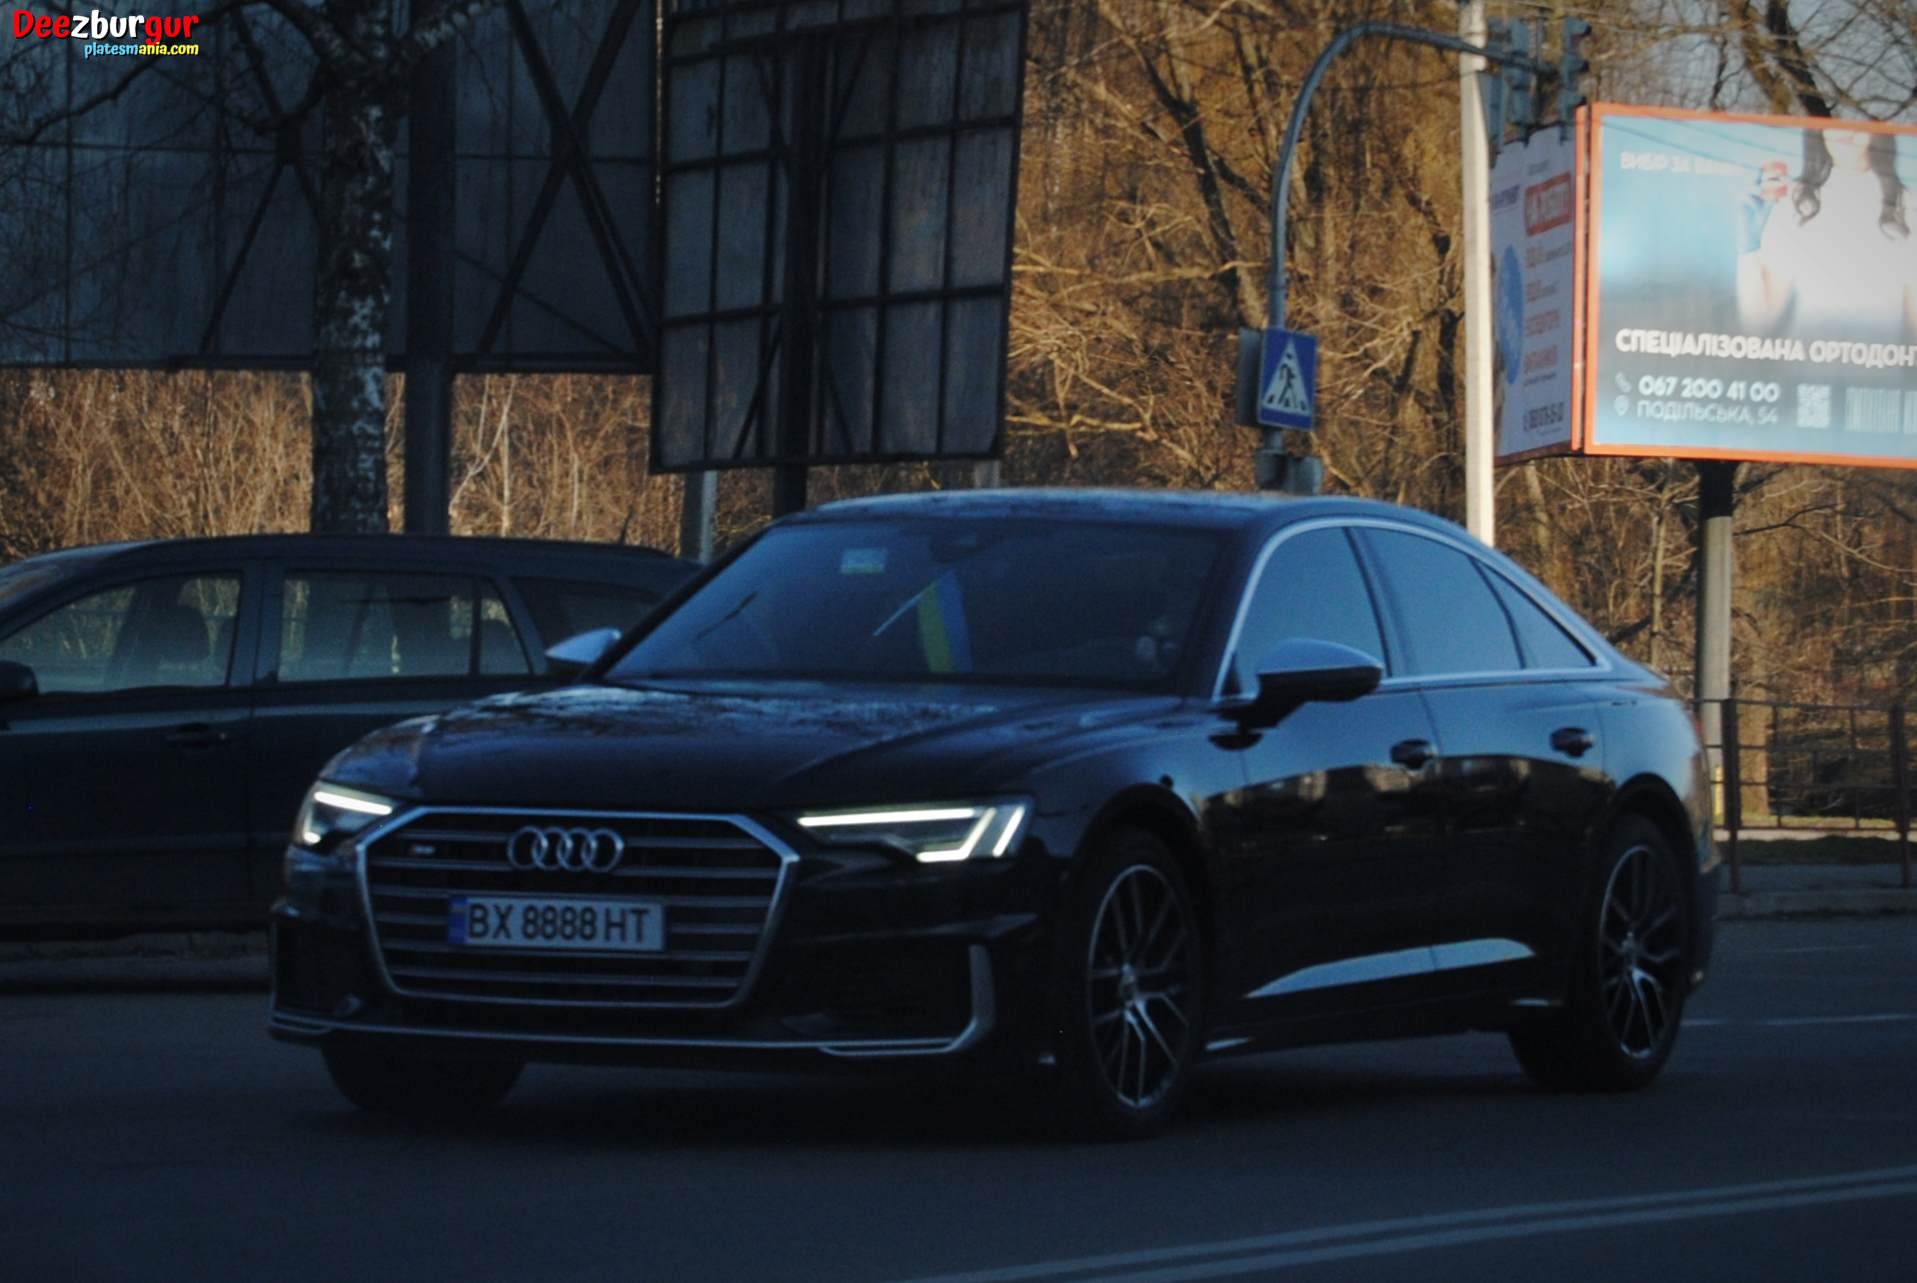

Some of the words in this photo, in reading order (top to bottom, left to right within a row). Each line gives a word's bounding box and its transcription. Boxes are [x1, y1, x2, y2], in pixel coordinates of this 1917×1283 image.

[1615, 328, 1806, 361] СПЕЦІАЛІЗОВАНА
[1808, 342, 1917, 368] ОРТОДОН
[1637, 375, 1676, 398] 067
[1681, 377, 1724, 400] 200
[1726, 380, 1747, 401] 41
[1750, 381, 1781, 403] 00
[468, 903, 513, 940] BX
[521, 904, 598, 941] 8888
[604, 907, 649, 943] HT
